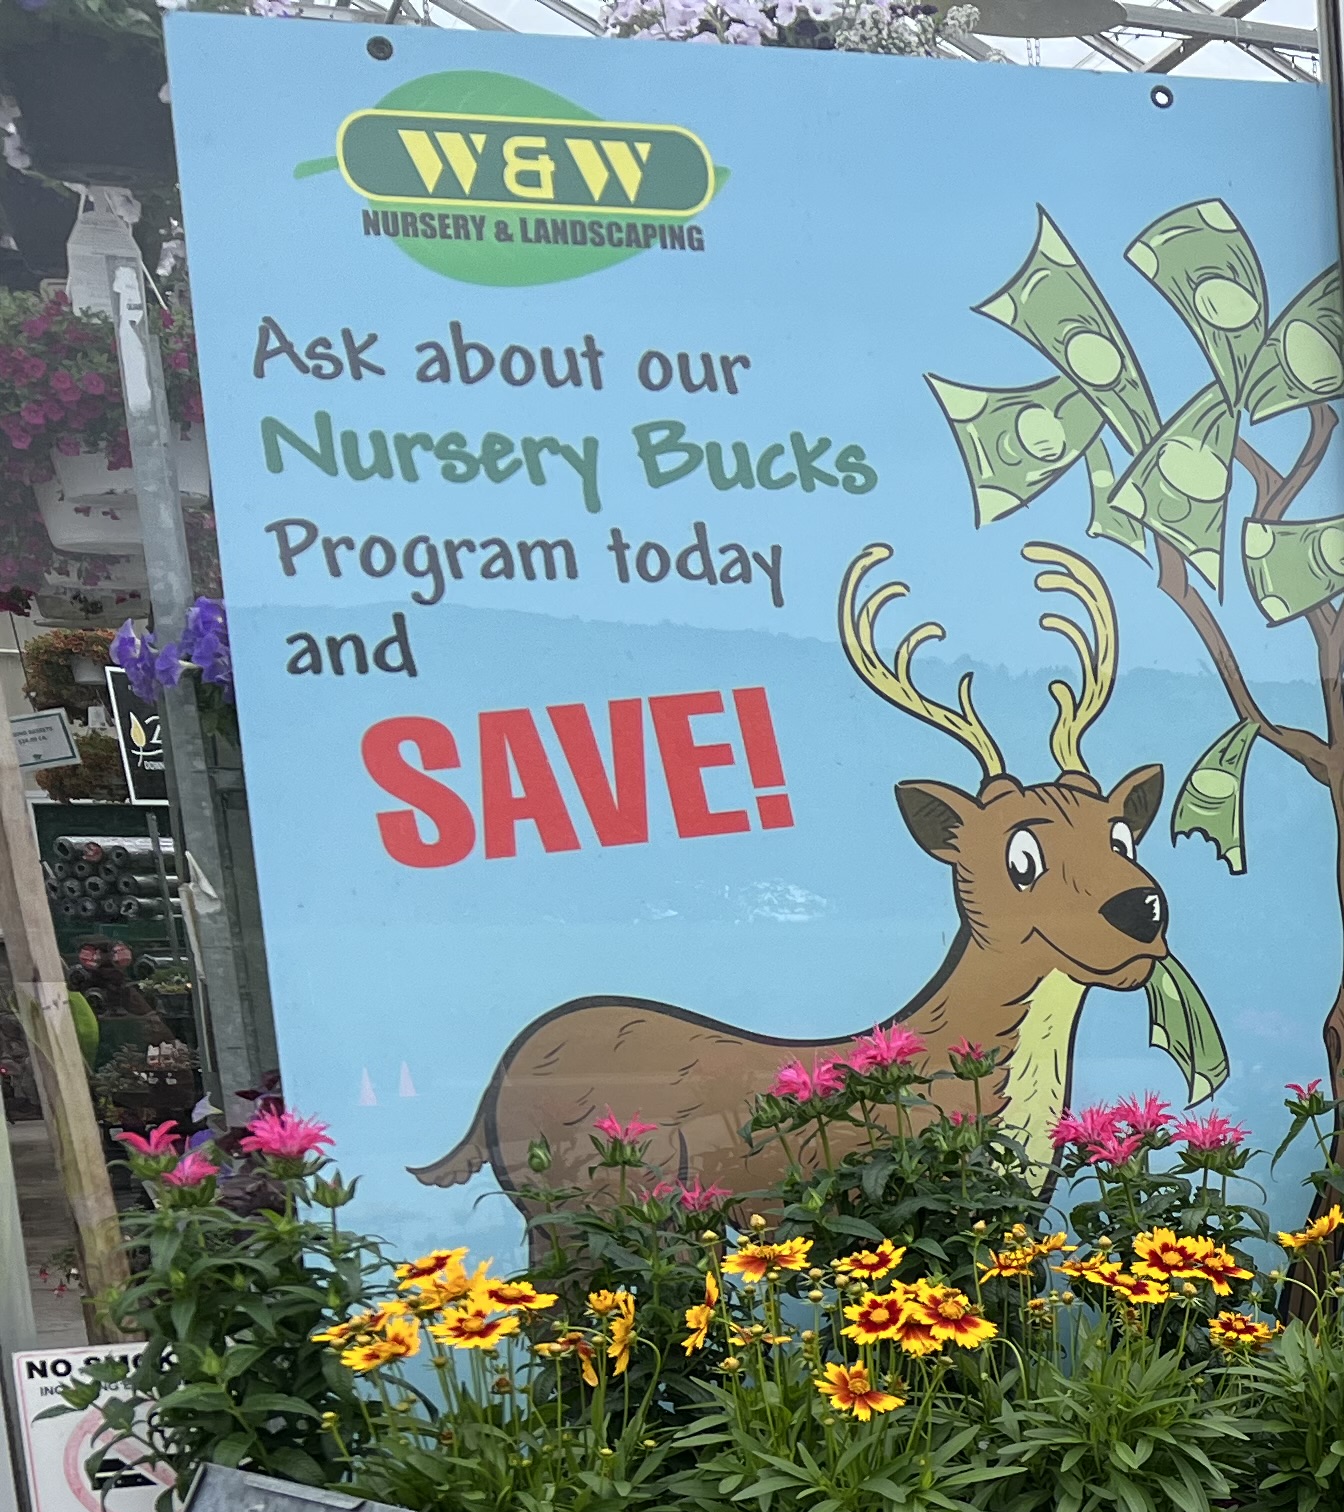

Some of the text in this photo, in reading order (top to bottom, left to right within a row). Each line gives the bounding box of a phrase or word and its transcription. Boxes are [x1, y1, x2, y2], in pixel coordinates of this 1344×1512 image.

[362, 209, 705, 251] NURSERY & LANDSCAPING
[254, 317, 751, 396] Ask about our
[261, 410, 879, 513] Nursery Bucks
[265, 518, 786, 607] Program today
[285, 615, 418, 678] and
[361, 687, 796, 869] SAVE!
[26, 1359, 71, 1379] NO
